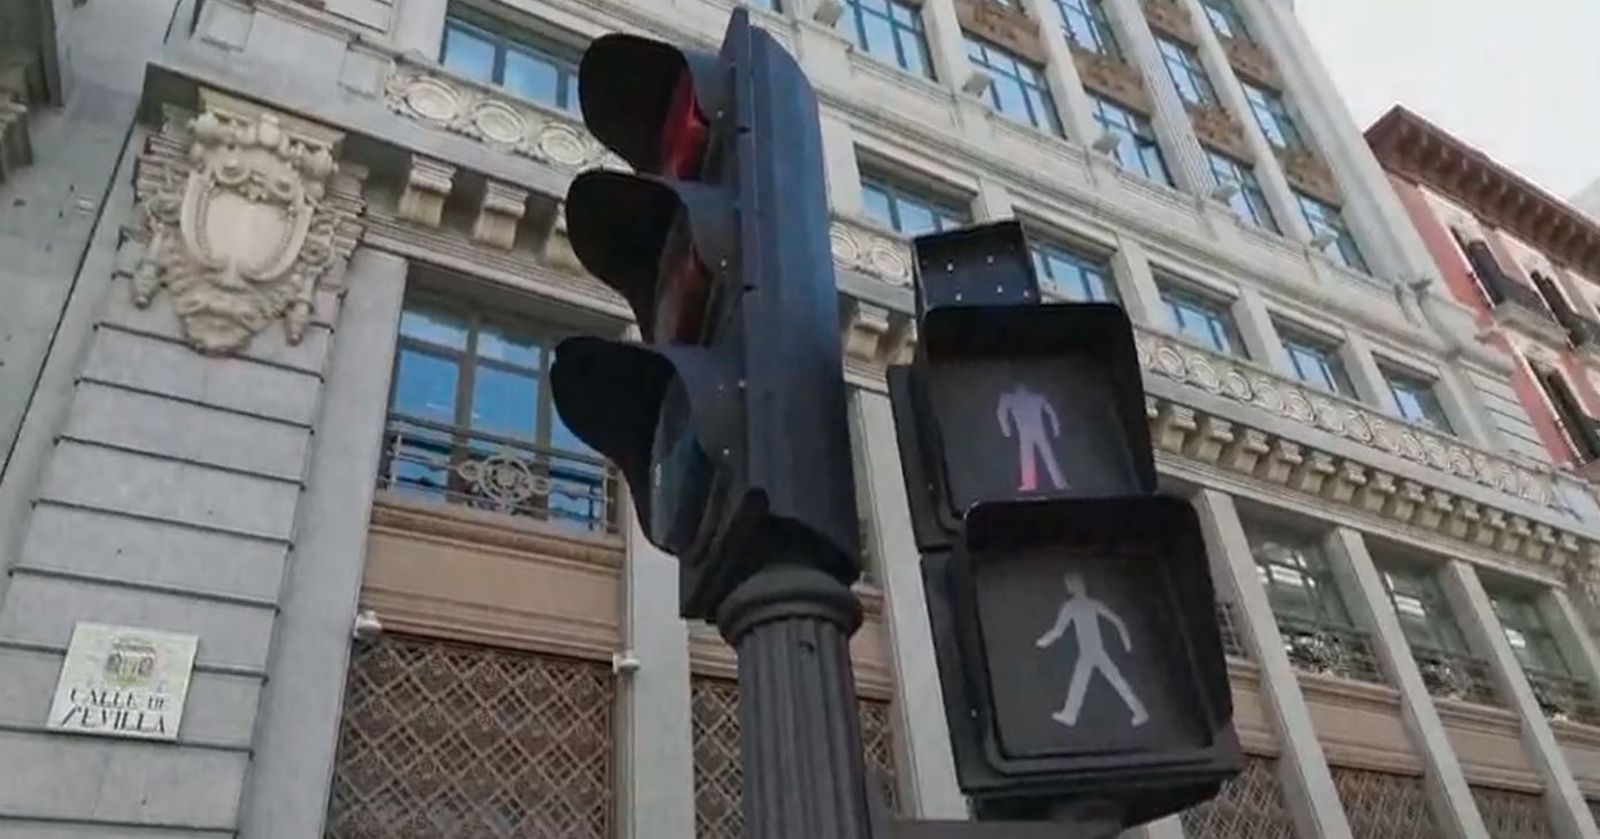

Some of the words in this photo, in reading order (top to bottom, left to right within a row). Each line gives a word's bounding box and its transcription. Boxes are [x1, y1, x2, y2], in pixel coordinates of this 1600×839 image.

[70, 688, 139, 710] CALLE
[147, 695, 165, 711] DE
[61, 705, 166, 733] SEVILLA
